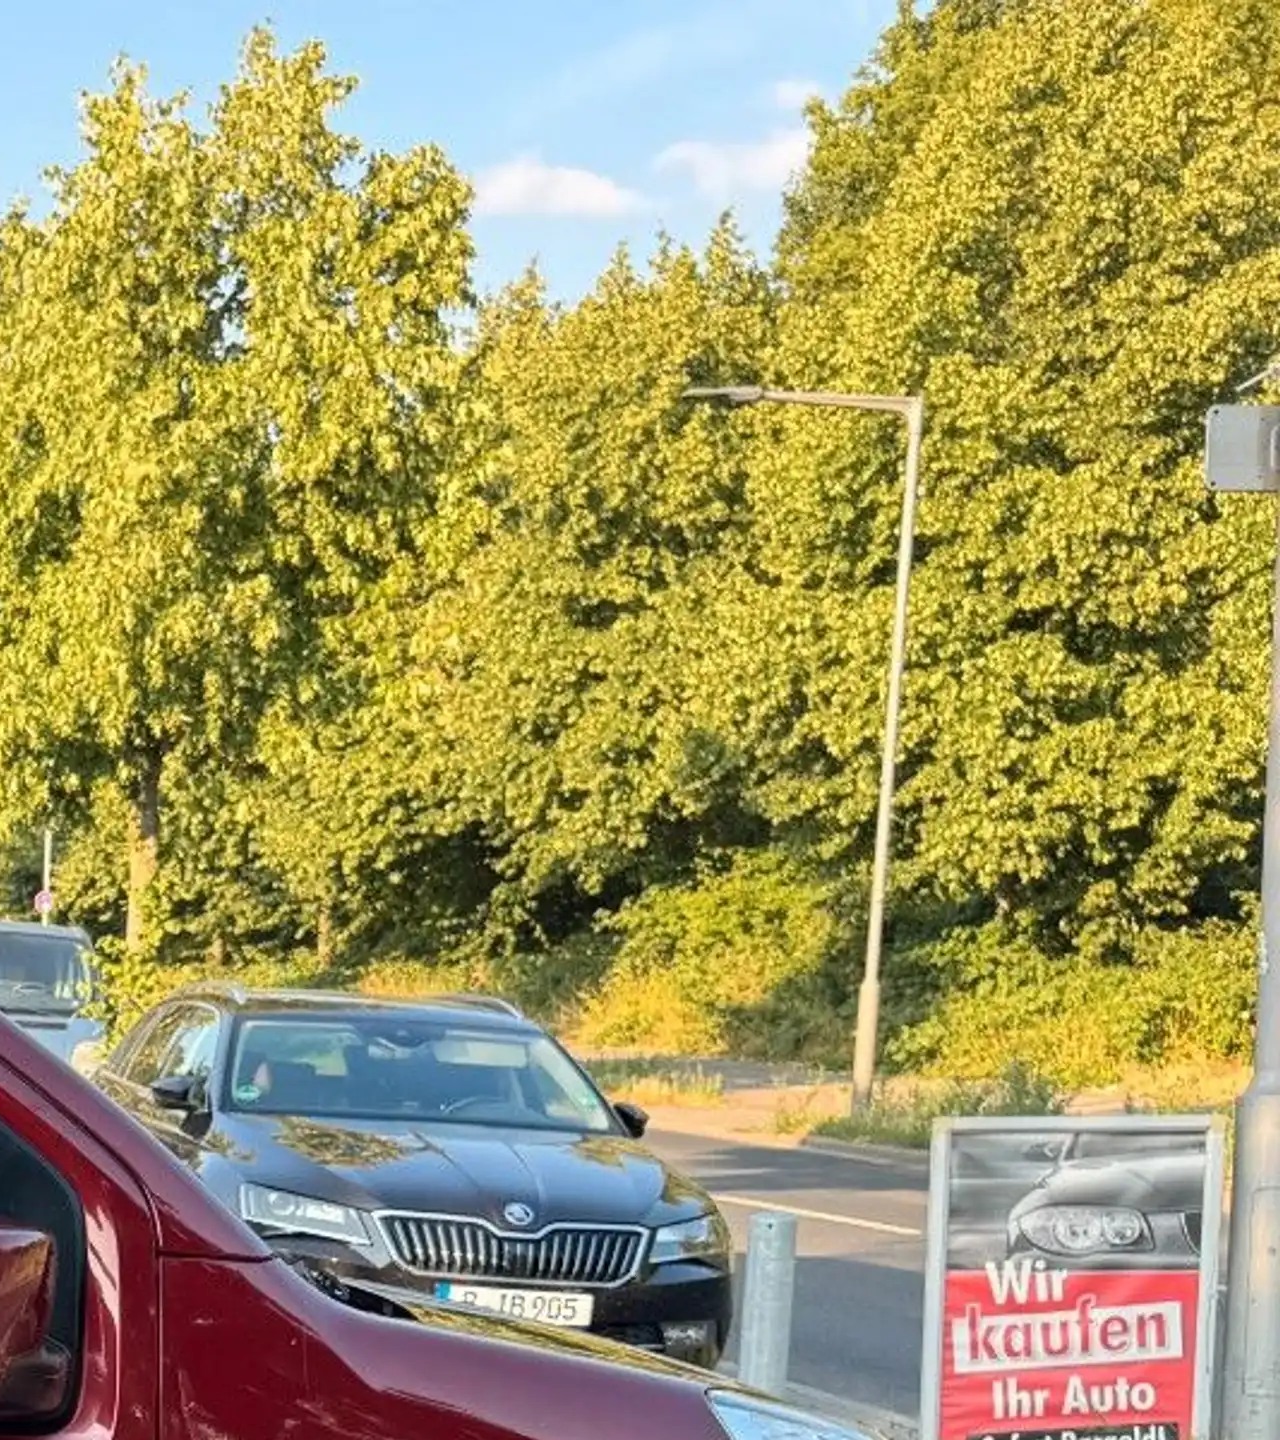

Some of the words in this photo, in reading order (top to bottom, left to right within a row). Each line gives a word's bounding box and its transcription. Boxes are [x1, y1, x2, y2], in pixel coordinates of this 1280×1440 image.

[985, 1258, 1068, 1305] Wir
[966, 1294, 1168, 1361] kaufen
[992, 1377, 1051, 1420] Ihr
[1061, 1374, 1156, 1416] Auto
